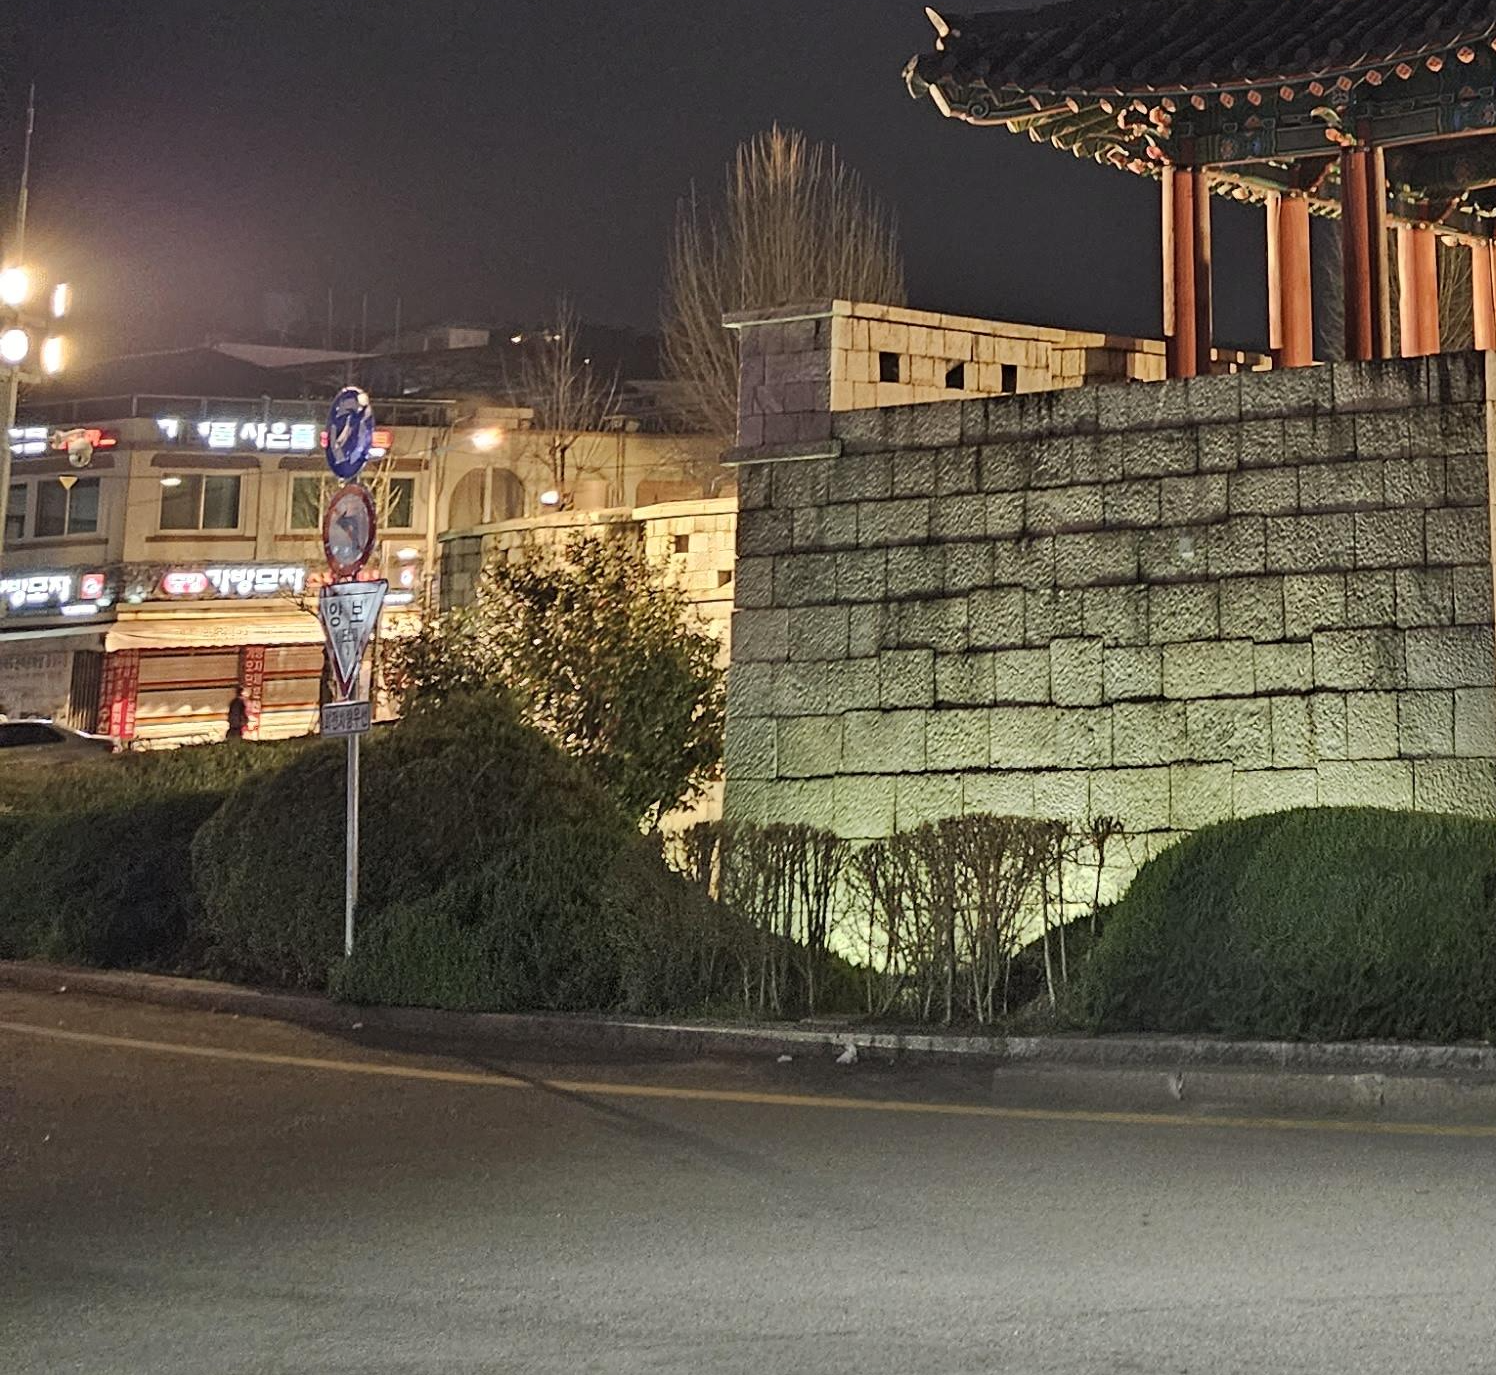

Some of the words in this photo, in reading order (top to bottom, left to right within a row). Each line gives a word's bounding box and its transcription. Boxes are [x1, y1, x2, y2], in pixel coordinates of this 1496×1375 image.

[240, 422, 316, 449] 사은품
[0, 576, 71, 607] 방모자
[205, 568, 304, 595] 가방모자
[328, 601, 365, 627] 양보
